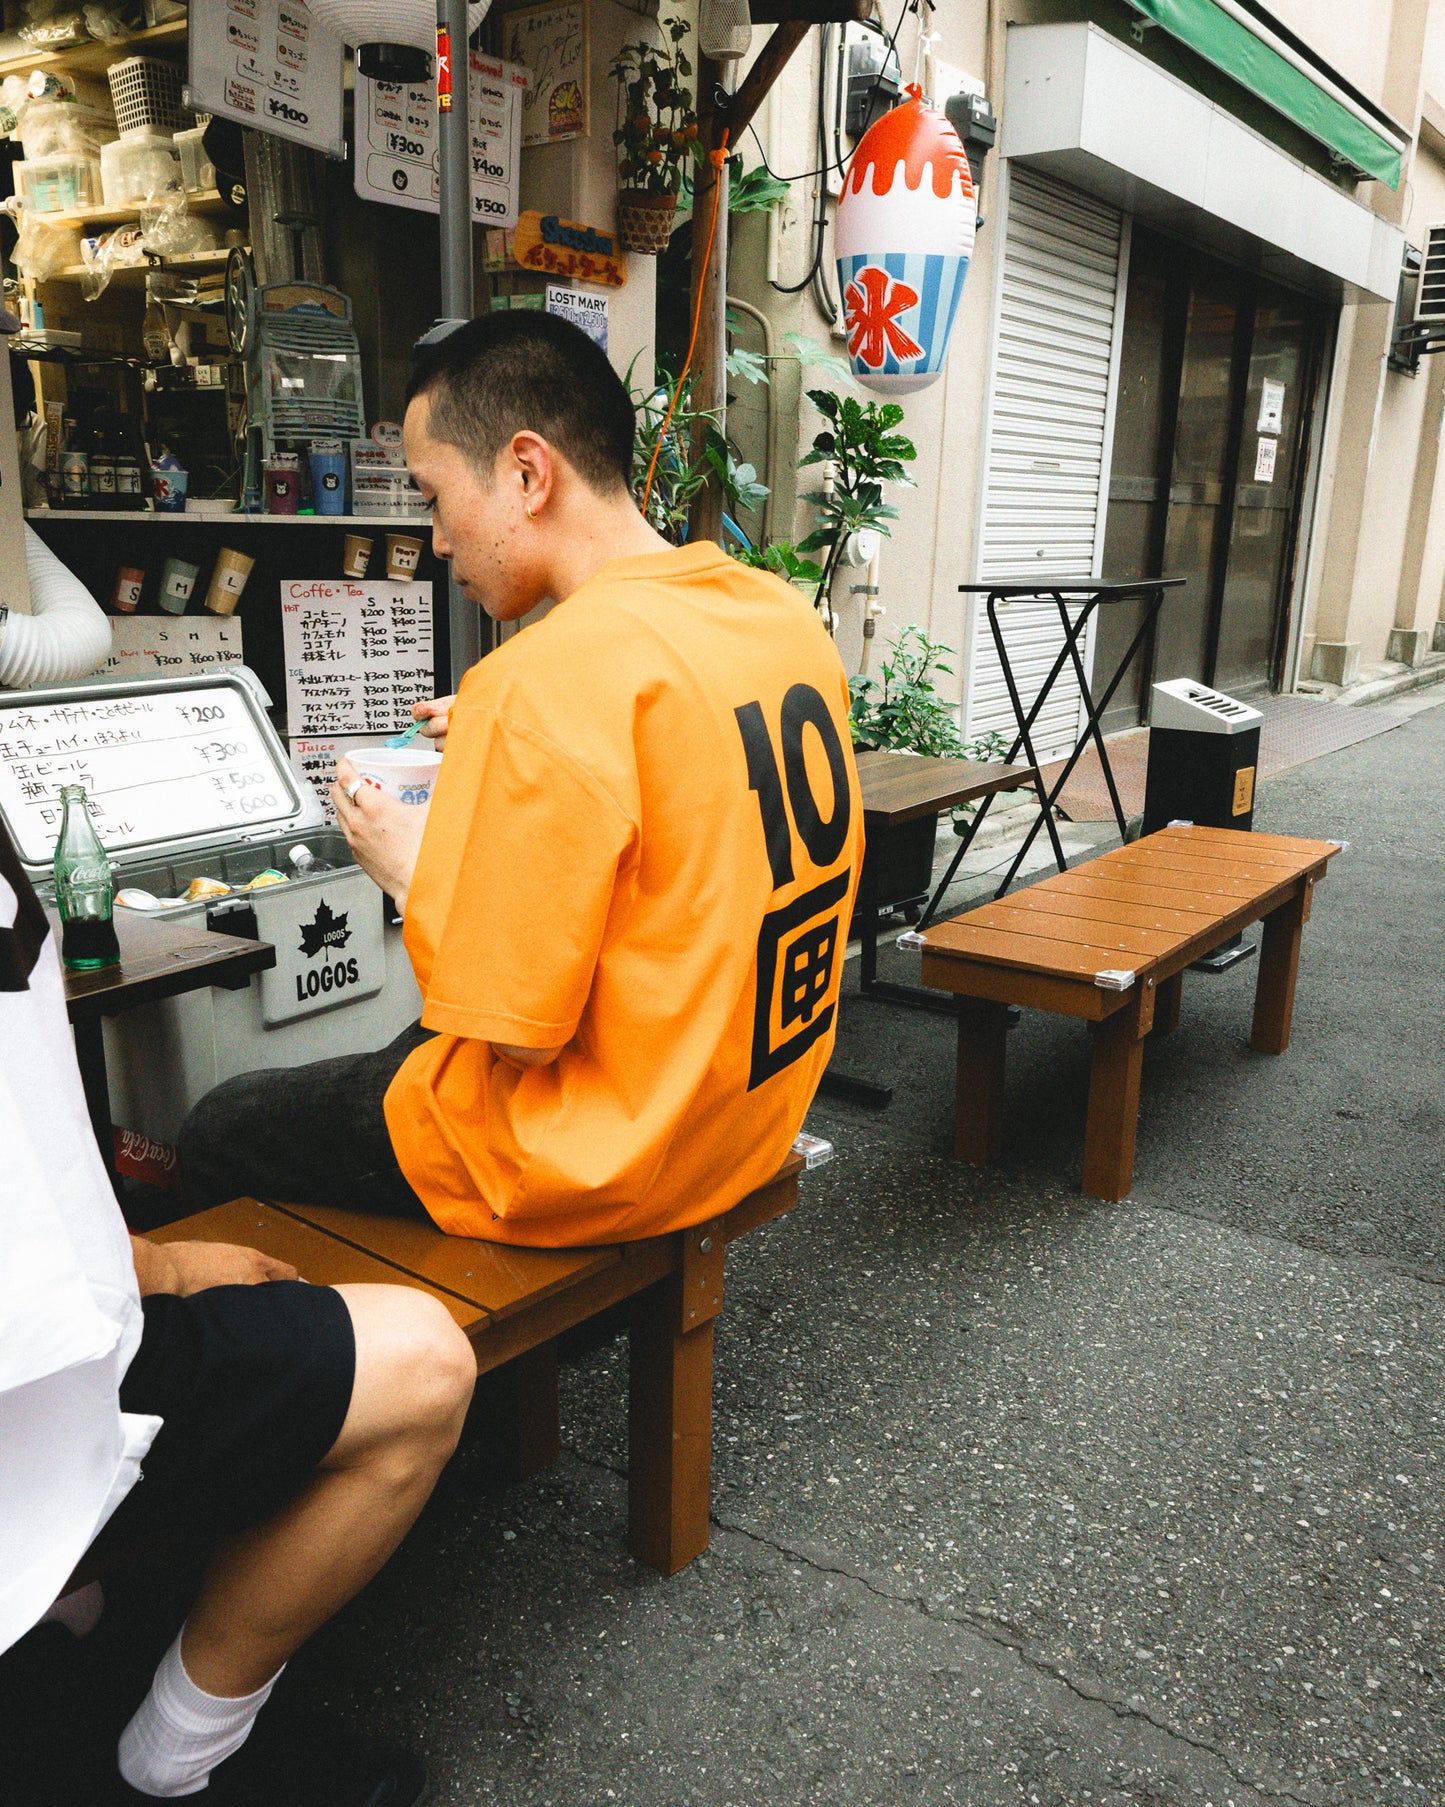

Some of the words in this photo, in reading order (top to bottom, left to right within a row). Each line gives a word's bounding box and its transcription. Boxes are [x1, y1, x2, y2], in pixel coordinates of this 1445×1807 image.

[511, 72, 528, 87] ice
[269, 97, 309, 125] ¥400
[390, 133, 424, 156] ¥300
[472, 156, 504, 178] ¥400
[475, 196, 507, 215] ¥500
[549, 290, 576, 306] LOST
[578, 295, 607, 312] MARY
[845, 266, 923, 368] 氷
[399, 558, 410, 566] M
[175, 583, 188, 594] M
[227, 577, 238, 588] L
[129, 587, 140, 601] S
[368, 597, 376, 607] S
[393, 597, 404, 605] M
[419, 596, 429, 605] L
[303, 610, 342, 619] コーヒー
[360, 608, 385, 618] ¥200
[390, 606, 416, 616] ¥300
[300, 618, 347, 630] カプチーノ
[391, 616, 416, 627] ¥400
[159, 632, 168, 641] S
[189, 632, 199, 640] M
[219, 631, 229, 641] L
[301, 630, 346, 640] カフェモカ
[361, 626, 387, 637] ¥400
[303, 640, 333, 650] ココア
[361, 638, 388, 648] ¥300
[393, 635, 417, 646] ¥400
[154, 654, 183, 666] ¥300
[189, 652, 215, 664] ¥600
[216, 650, 242, 662] ¥800
[361, 648, 390, 659] ¥300
[364, 671, 390, 682] ¥300
[393, 669, 416, 681] ¥500
[363, 685, 390, 696] ¥300
[391, 684, 414, 694] ¥500
[363, 698, 389, 708] ¥300
[392, 697, 416, 708] ¥500
[175, 705, 226, 726] ¥200
[303, 712, 350, 723] アイスティー
[364, 710, 390, 720] ¥100
[366, 720, 389, 731] ¥100
[393, 720, 415, 730] ¥200
[193, 741, 249, 764] ¥300
[297, 741, 336, 753] Juice
[211, 772, 266, 795] ¥500
[734, 683, 851, 893] 10
[219, 794, 278, 815] ¥600
[323, 928, 345, 943] LOGOS
[296, 957, 359, 1002] LOGOS
